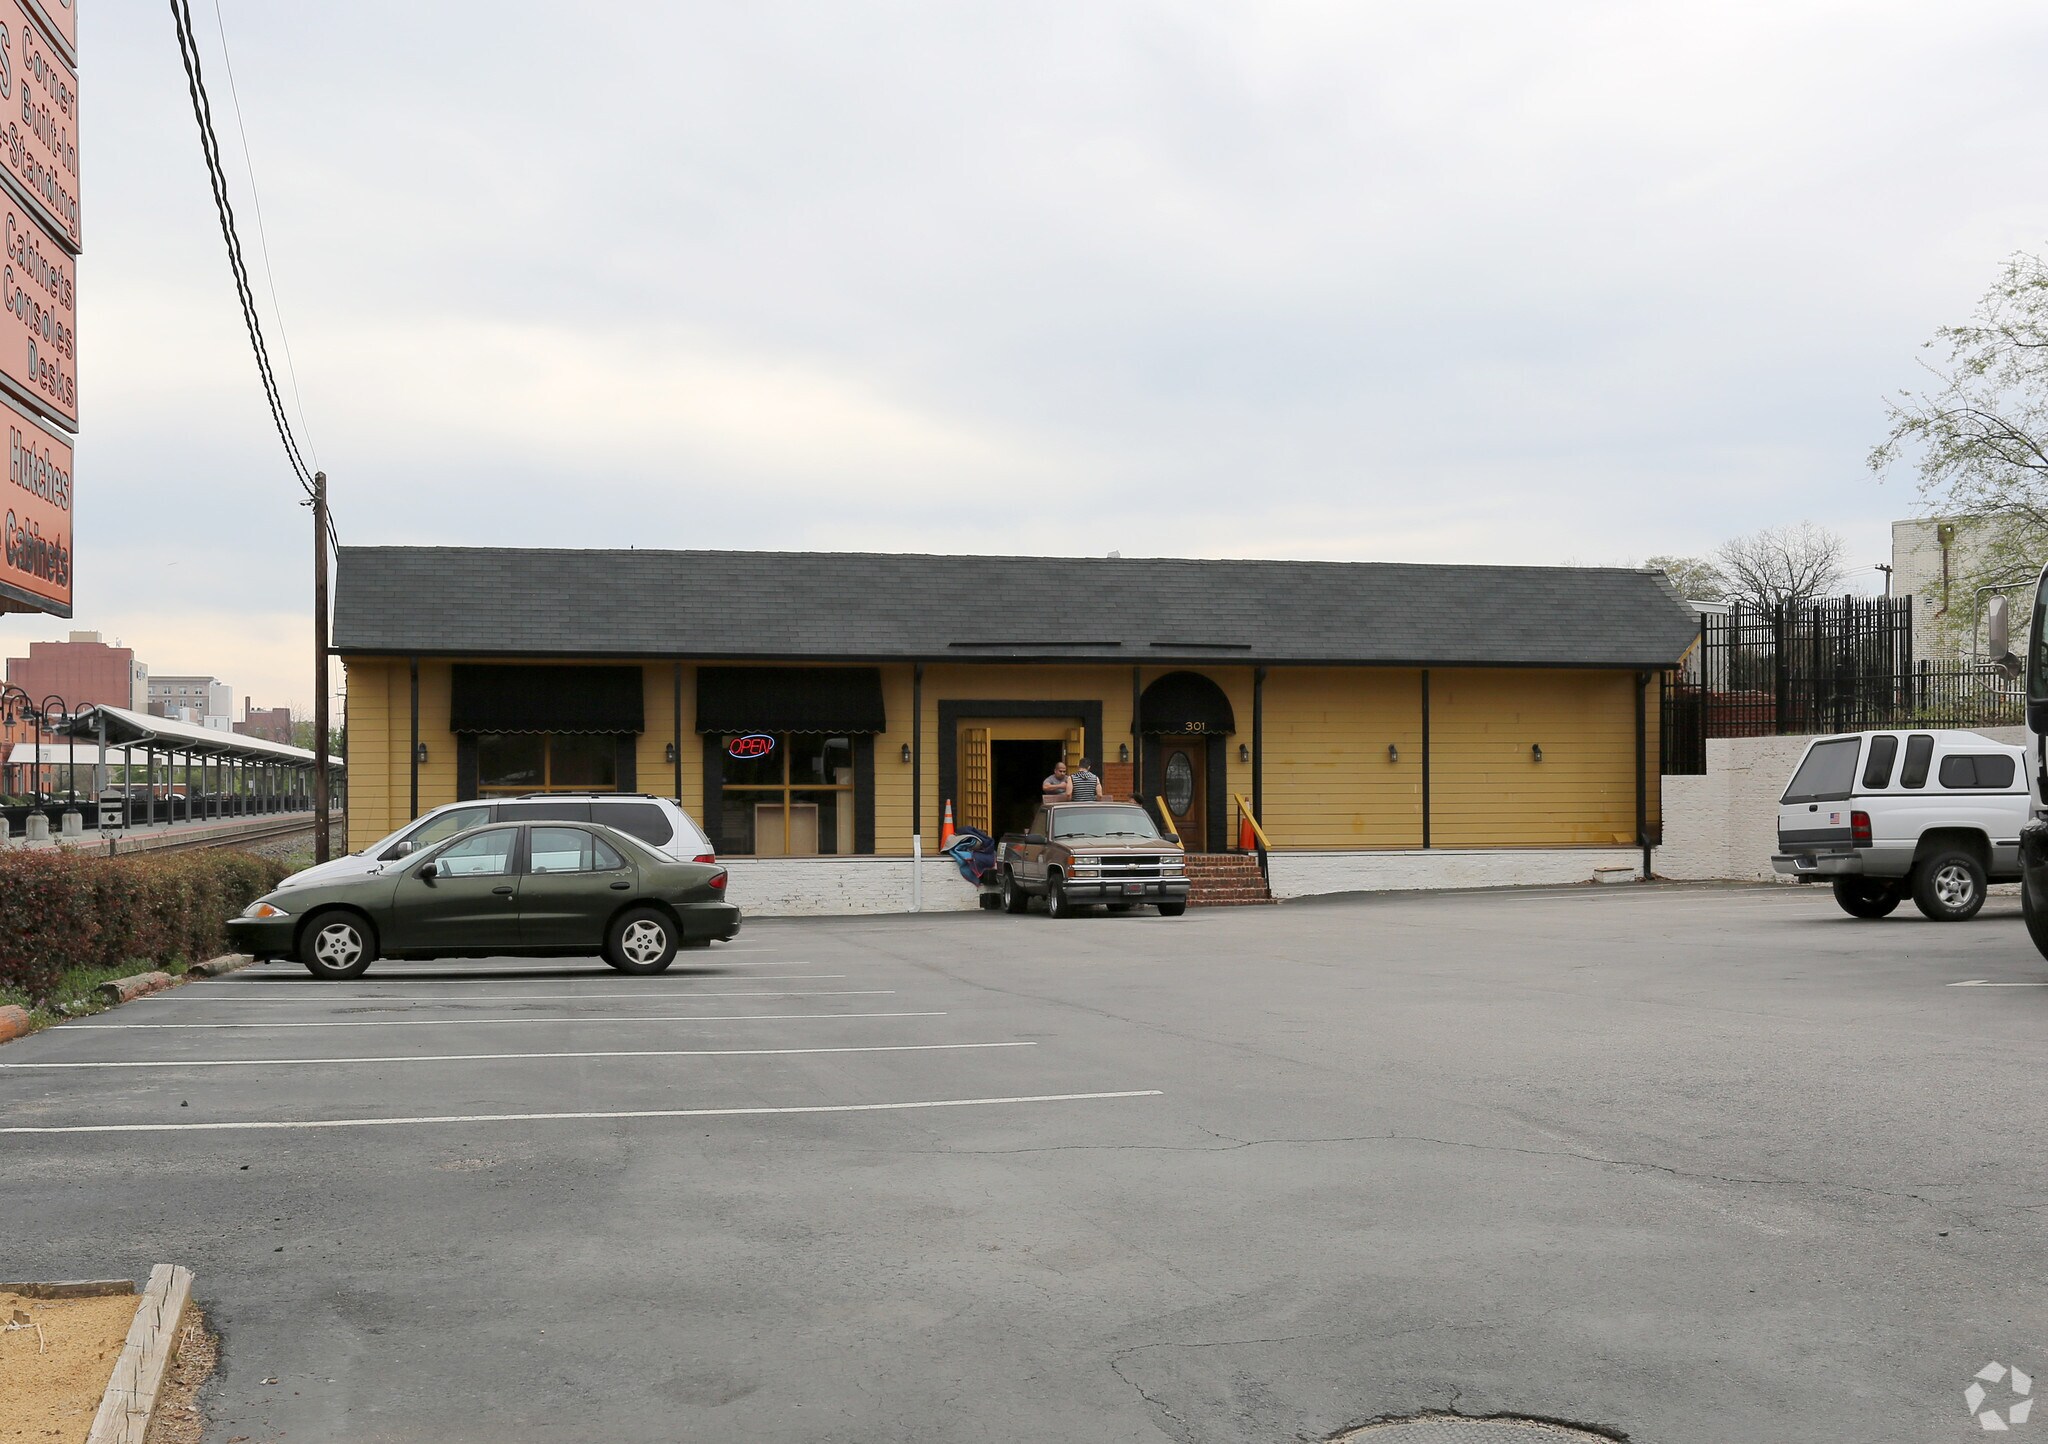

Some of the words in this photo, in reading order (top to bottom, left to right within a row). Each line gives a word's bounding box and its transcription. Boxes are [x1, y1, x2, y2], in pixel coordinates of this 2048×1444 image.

[22, 25, 75, 121] Corner
[21, 77, 76, 178] Built-In
[0, 121, 77, 239] -Standing
[5, 211, 73, 312] Cabinets
[3, 263, 73, 361] Consoles
[27, 335, 74, 408] Desks
[9, 425, 70, 511] Hutches
[5, 508, 69, 588] Cabinets
[730, 738, 772, 755] OPEN
[1185, 722, 1205, 731] 301
